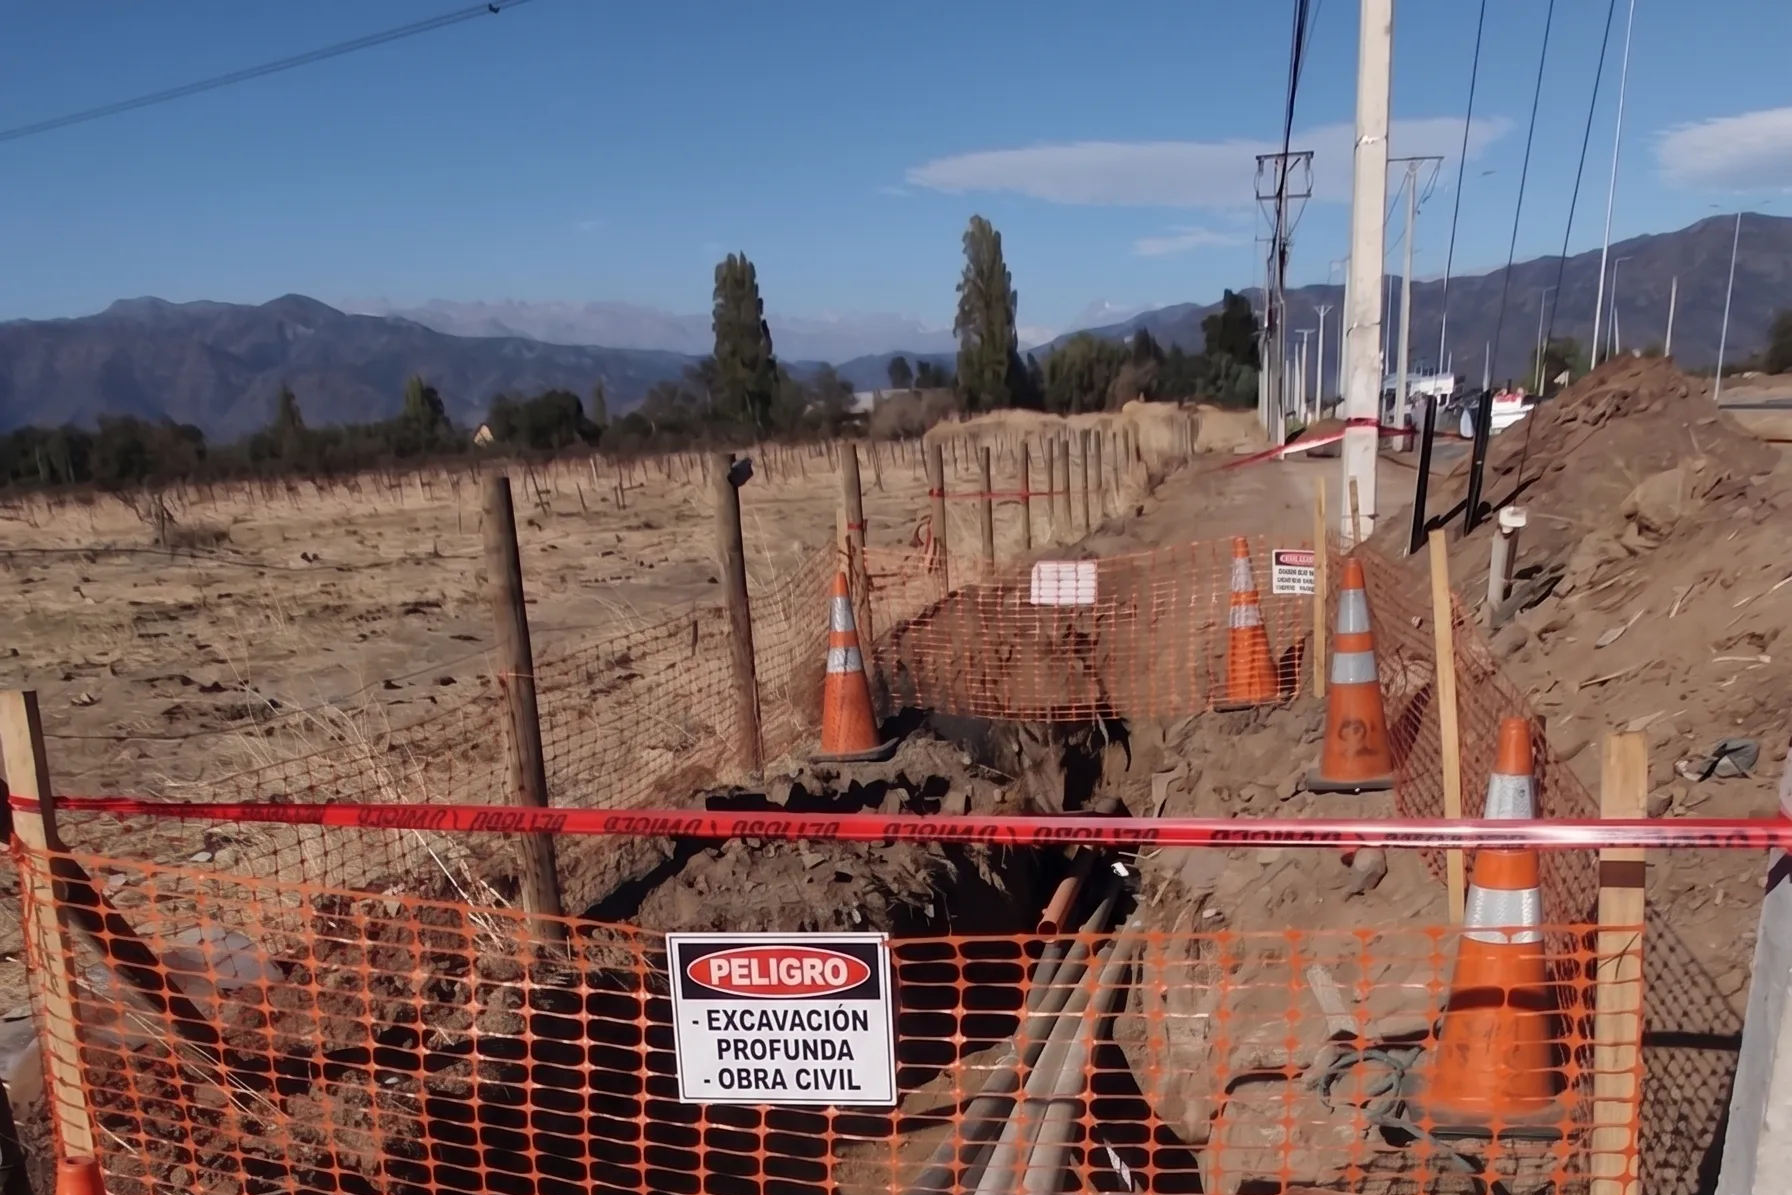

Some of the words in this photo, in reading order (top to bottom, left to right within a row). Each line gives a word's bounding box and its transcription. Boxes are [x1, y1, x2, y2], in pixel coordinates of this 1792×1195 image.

[709, 957, 848, 986] PELIGRO
[706, 1004, 869, 1032] EXCAVACIÓN
[717, 1038, 854, 1061] PROFUNDA
[718, 1067, 787, 1090] OBRA
[795, 1068, 861, 1090] CIVIL
